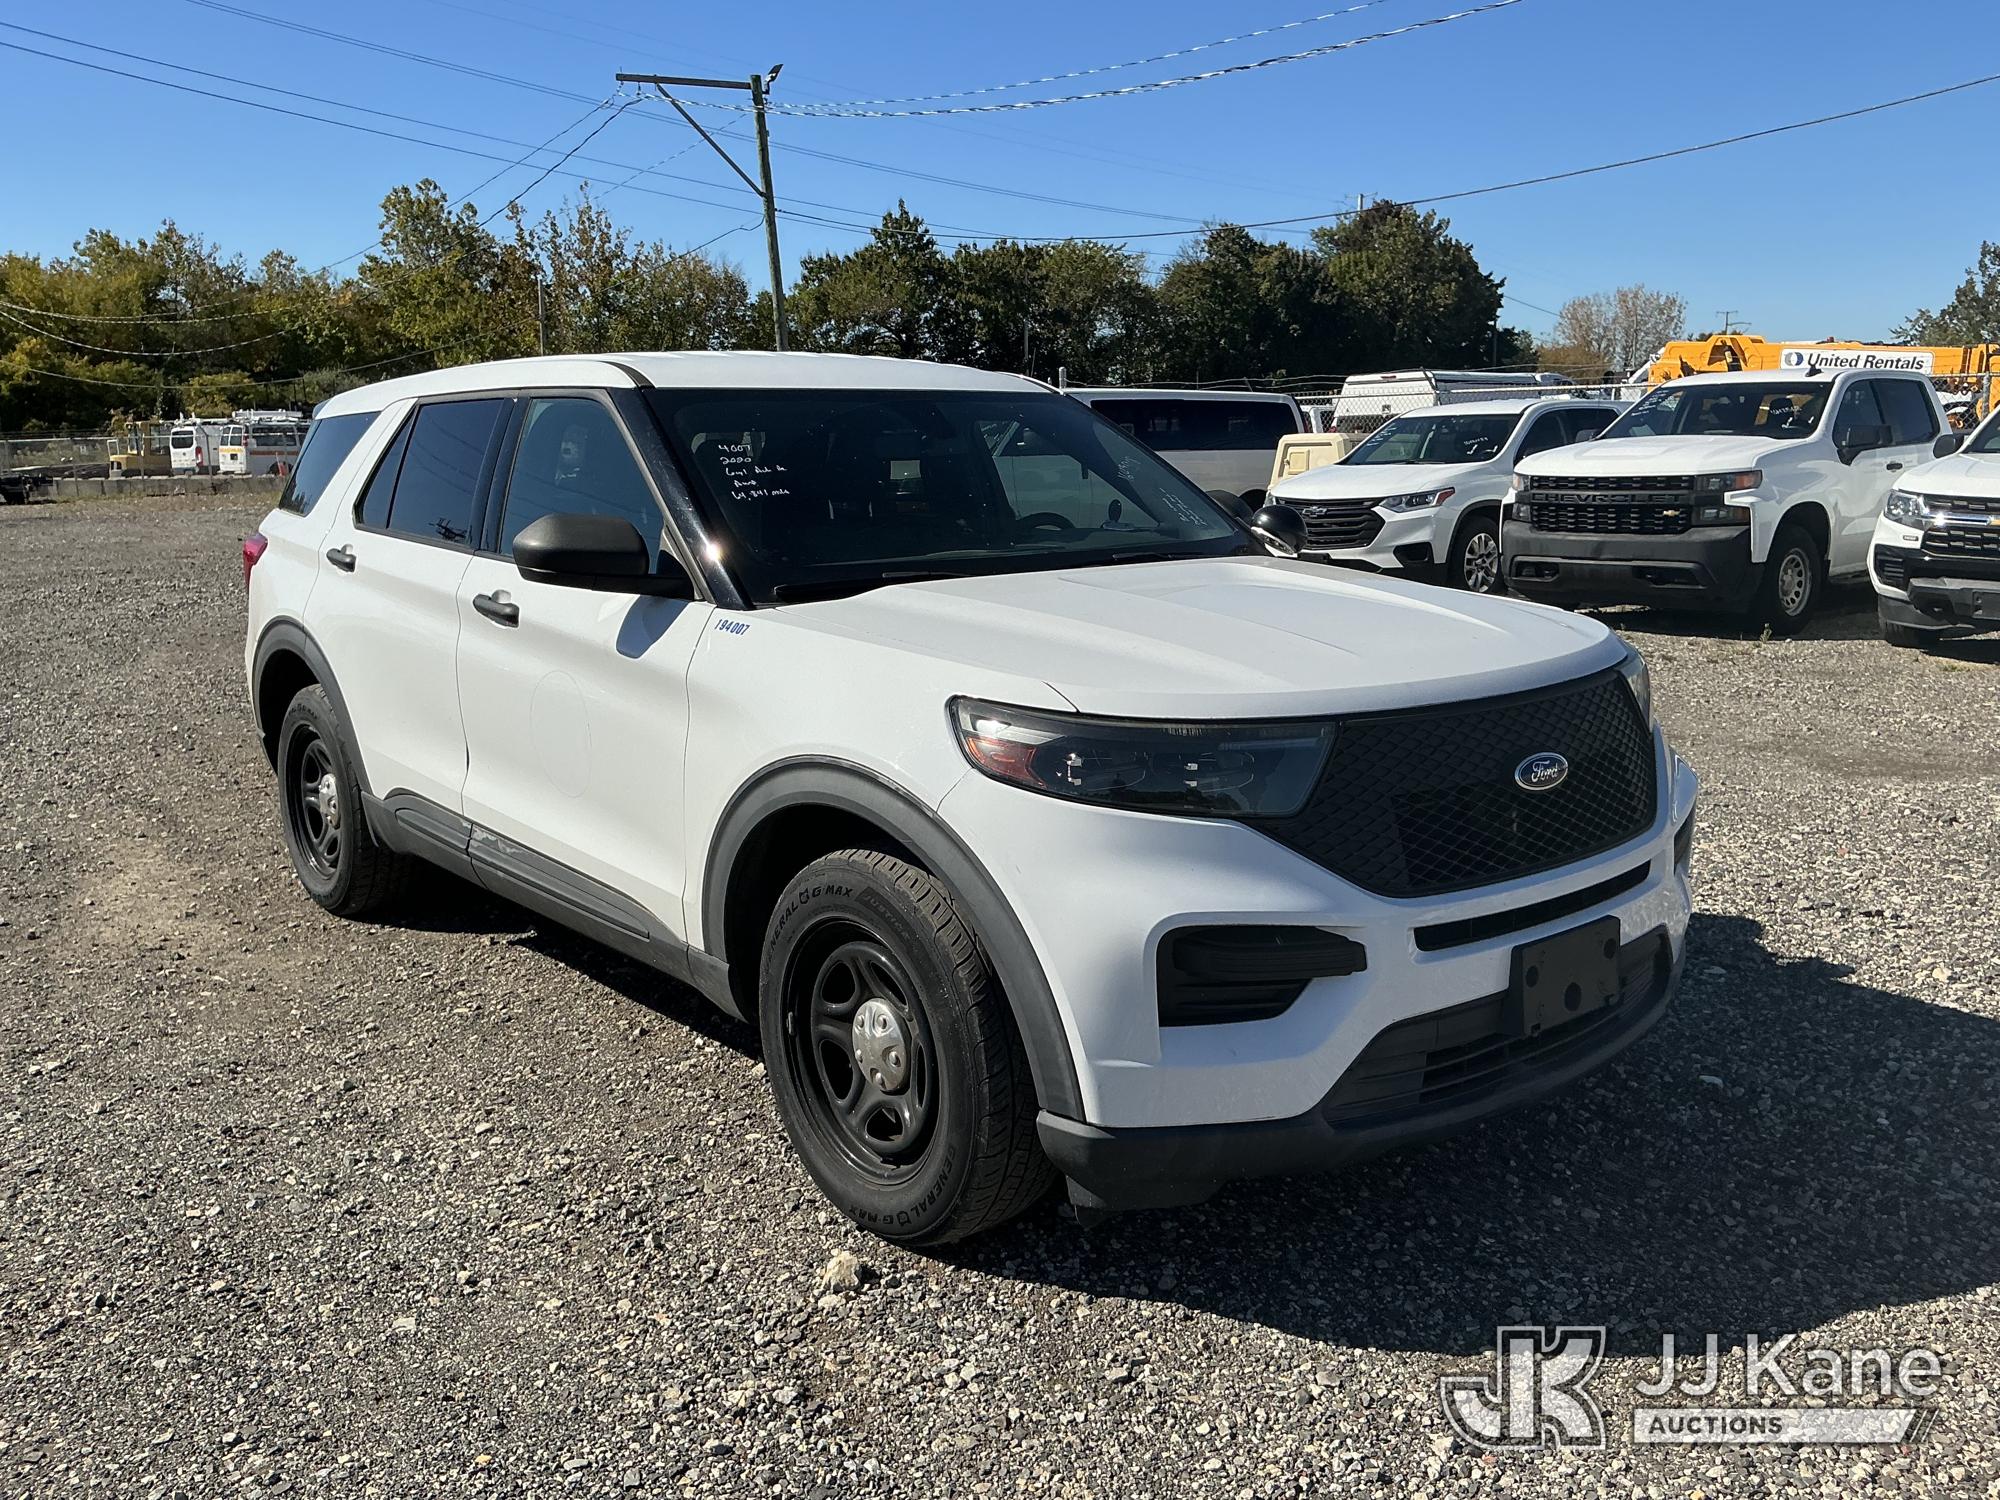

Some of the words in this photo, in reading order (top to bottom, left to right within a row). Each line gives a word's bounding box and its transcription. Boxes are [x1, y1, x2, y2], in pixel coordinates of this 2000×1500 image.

[1807, 352, 1858, 369] United
[1863, 354, 1925, 371] Rentals
[1532, 493, 1681, 504] CHEVROLET
[714, 618, 751, 636] 194007
[1531, 759, 1558, 782] Ford
